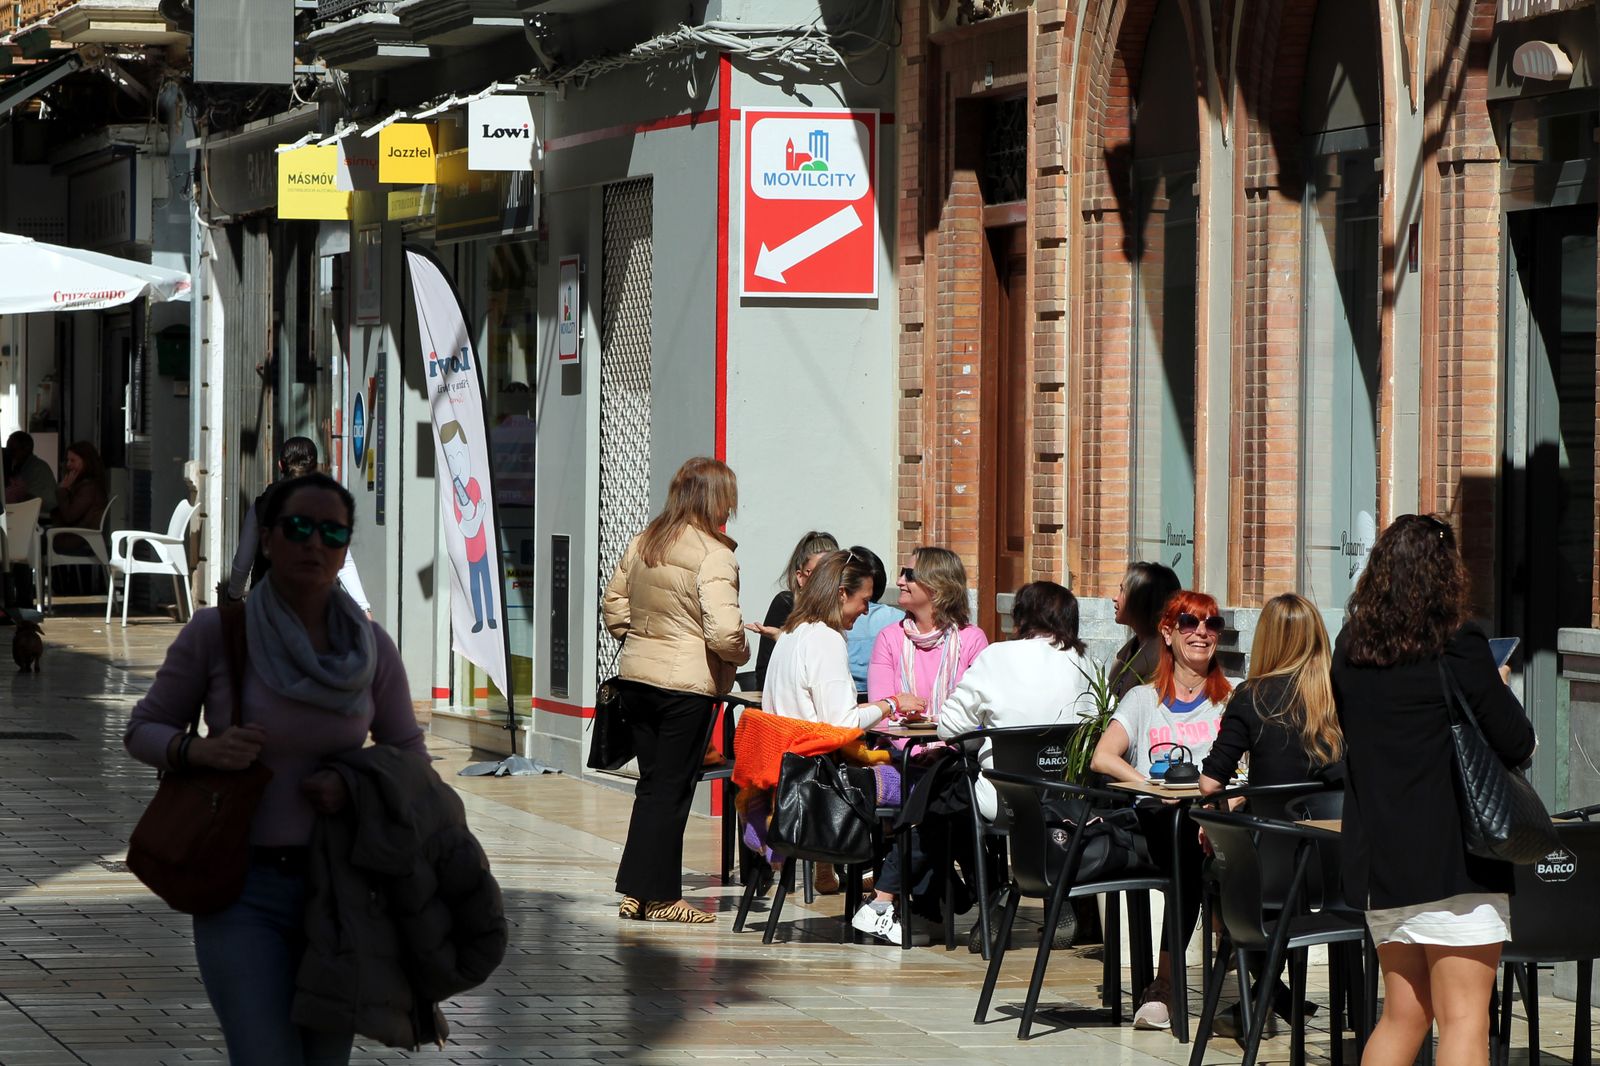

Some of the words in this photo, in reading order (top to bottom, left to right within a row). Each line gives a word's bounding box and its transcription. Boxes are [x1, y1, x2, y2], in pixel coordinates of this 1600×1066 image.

[481, 123, 530, 140] Lowi
[387, 146, 431, 158] Jazztel
[343, 155, 378, 170] simy
[287, 171, 334, 185] MÁSMÓV
[763, 172, 856, 187] MOVILCITY
[53, 289, 126, 303] Cruzcampo
[1038, 757, 1068, 766] BARCO
[1537, 863, 1575, 874] BARCO
